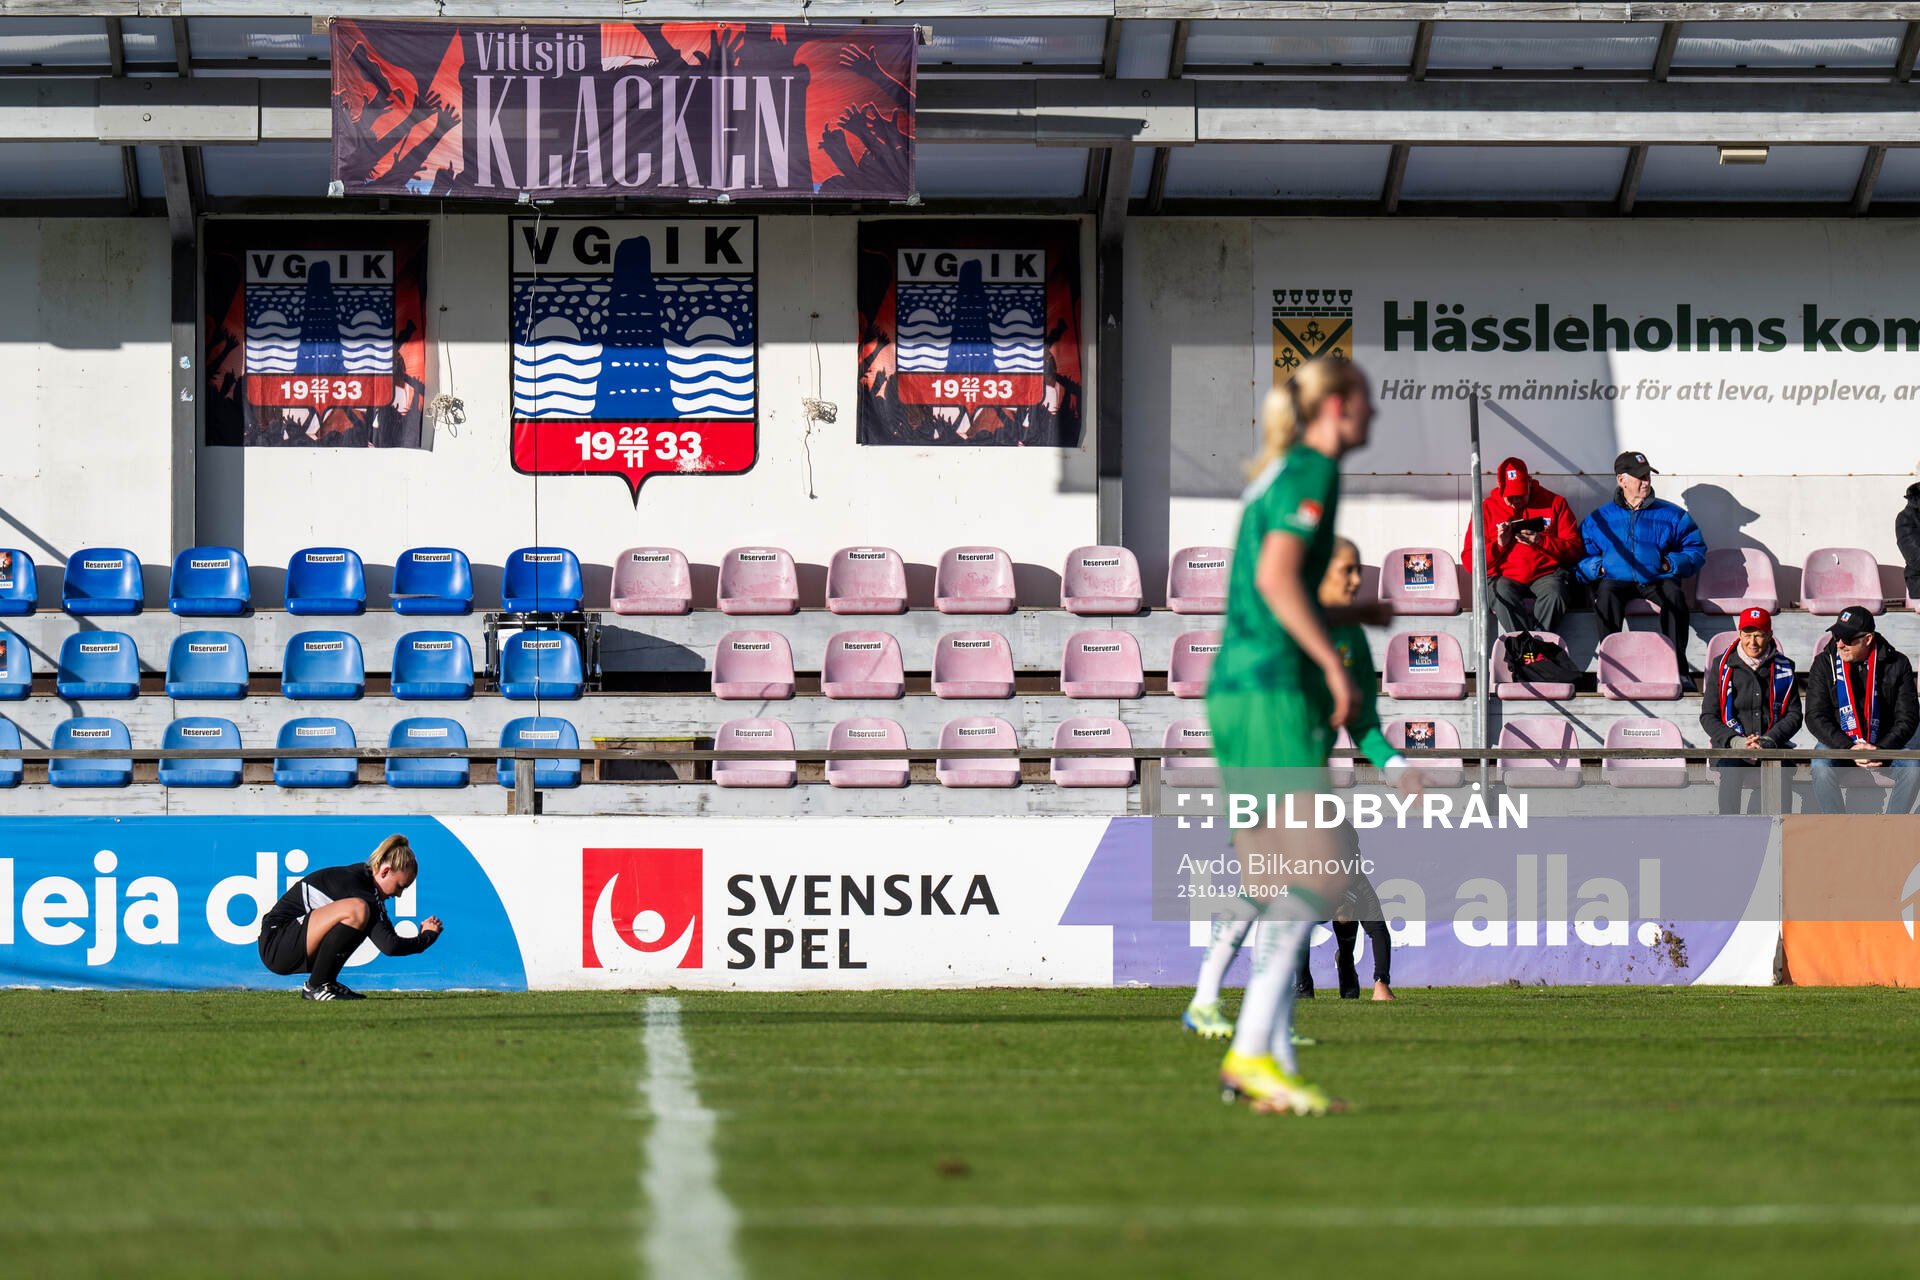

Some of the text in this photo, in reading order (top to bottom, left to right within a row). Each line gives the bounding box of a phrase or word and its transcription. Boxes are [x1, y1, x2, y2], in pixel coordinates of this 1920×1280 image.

[473, 31, 586, 79] Vittsjö
[472, 75, 795, 191] KLACKEN
[1383, 300, 1787, 352] Hässleholms
[1380, 379, 1426, 400] Här
[1431, 379, 1492, 401] möts
[1498, 379, 1630, 401] människor
[1636, 379, 1672, 400] för
[1676, 381, 1714, 401] att
[1717, 379, 1775, 403] leva,
[1782, 379, 1887, 406] uppleva,
[306, 554, 344, 562] Reserverad
[414, 553, 451, 561] Reserverad
[524, 553, 562, 562] Reserverad
[633, 554, 670, 562] Reserverad
[849, 552, 886, 560] Reserverad
[958, 553, 994, 561] Reserverad
[84, 560, 122, 569] Reserverad
[192, 560, 229, 568] Reserverad
[1082, 558, 1119, 567] Reserverad
[1188, 561, 1224, 569] Reserverad
[80, 644, 119, 652] Reserverad
[190, 644, 228, 652] Reserverad
[305, 641, 342, 650] Reserverad
[414, 641, 452, 649] Reserverad
[522, 640, 560, 649] Reserverad
[733, 642, 770, 650] Reserverad
[844, 642, 881, 650] Reserverad
[1083, 644, 1120, 652] Reserverad
[1191, 645, 1224, 653] Reserver
[72, 729, 110, 737] Reserverad
[182, 728, 221, 736] Reserverad
[297, 727, 335, 735] Reserverad
[408, 728, 447, 736] Reserverad
[520, 731, 558, 739] Reserverad
[735, 729, 773, 737] Reserverad
[848, 729, 886, 737] Reserverad
[958, 727, 996, 735] Reserverad
[1073, 728, 1111, 736] Reserverad
[1183, 729, 1216, 737] Reserver
[727, 874, 1000, 916] SVENSKA
[1452, 854, 1661, 947] alla!
[0, 849, 419, 967] eja d!
[727, 928, 868, 970] SPEL
